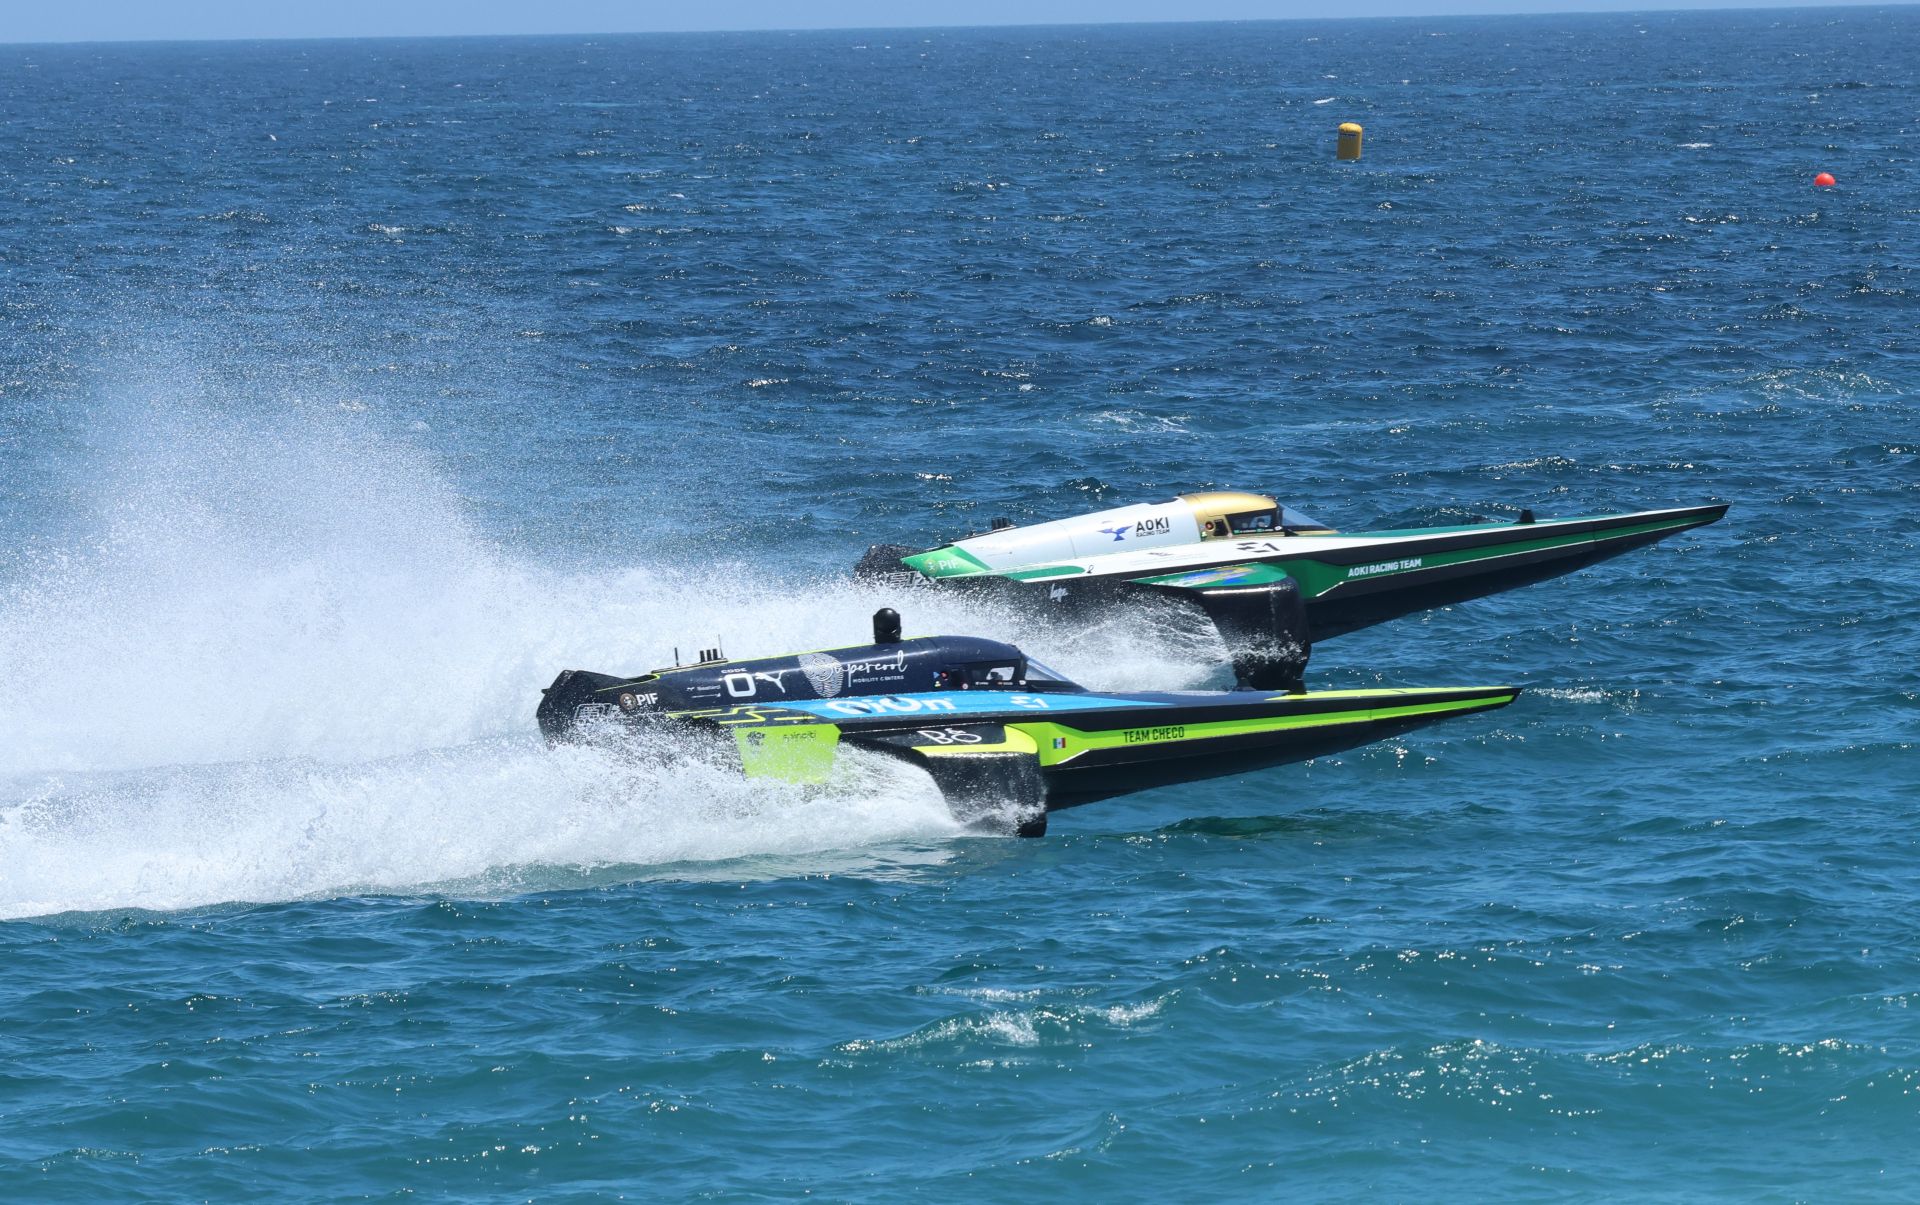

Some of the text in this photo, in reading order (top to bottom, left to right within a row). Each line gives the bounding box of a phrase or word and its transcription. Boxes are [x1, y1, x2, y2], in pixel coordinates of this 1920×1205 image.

[1135, 516, 1170, 533] AOKI
[1155, 528, 1171, 536] TEAM
[1347, 557, 1422, 578] AOKI RACING TEAM
[852, 676, 879, 684] MOBILITY
[635, 692, 659, 706] PIF
[1122, 726, 1186, 743] TEAM CHECO
